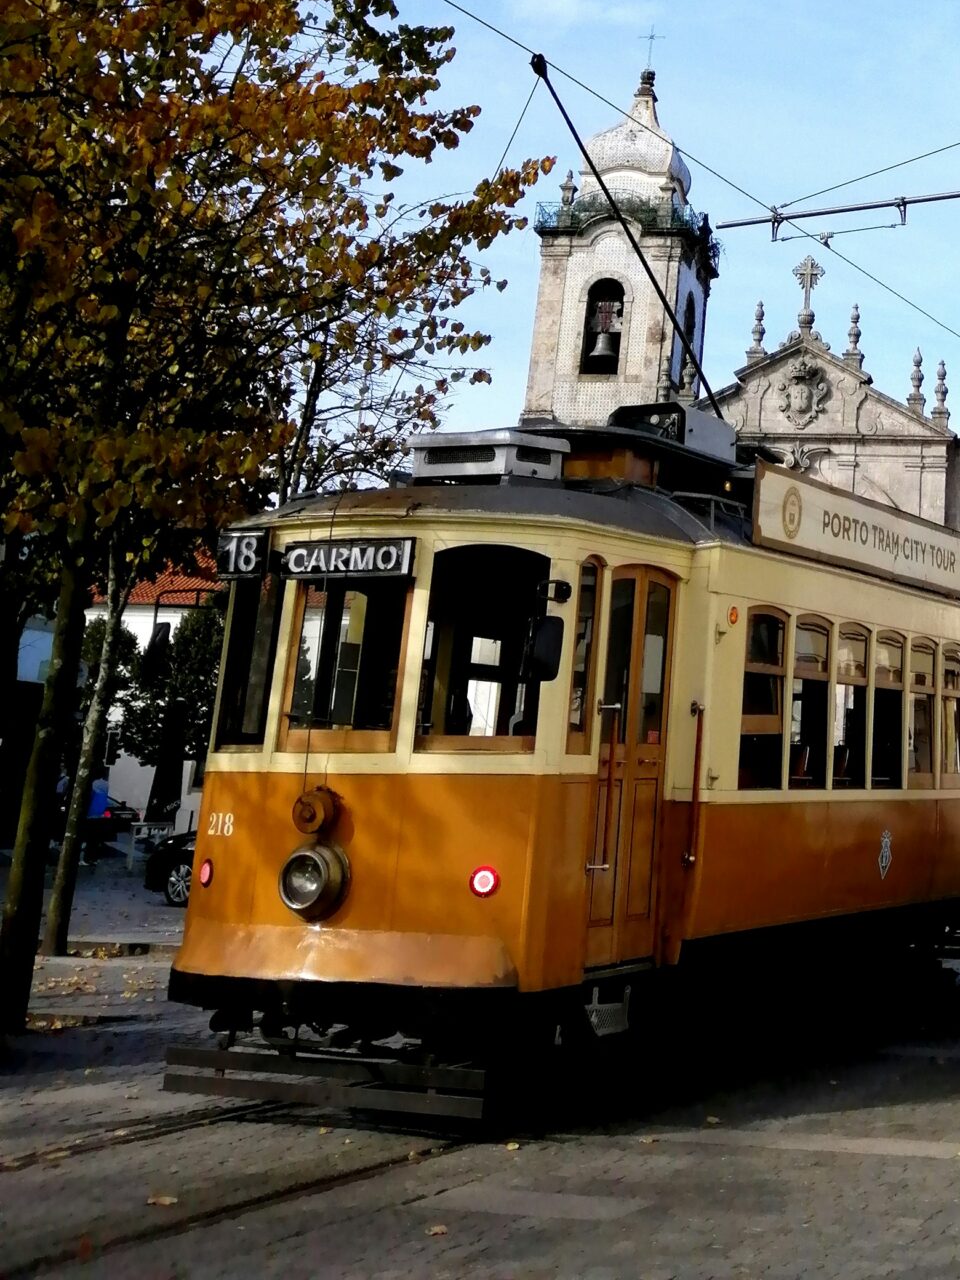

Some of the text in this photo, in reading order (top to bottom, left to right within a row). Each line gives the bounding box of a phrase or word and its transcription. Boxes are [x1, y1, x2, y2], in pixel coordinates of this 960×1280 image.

[223, 537, 258, 572] 18
[822, 510, 869, 545] PORTO
[872, 525, 900, 556] TRAM
[902, 537, 927, 563] CITY
[930, 544, 956, 573] TOUR
[288, 545, 398, 573] CARMO
[207, 812, 234, 837] 218
